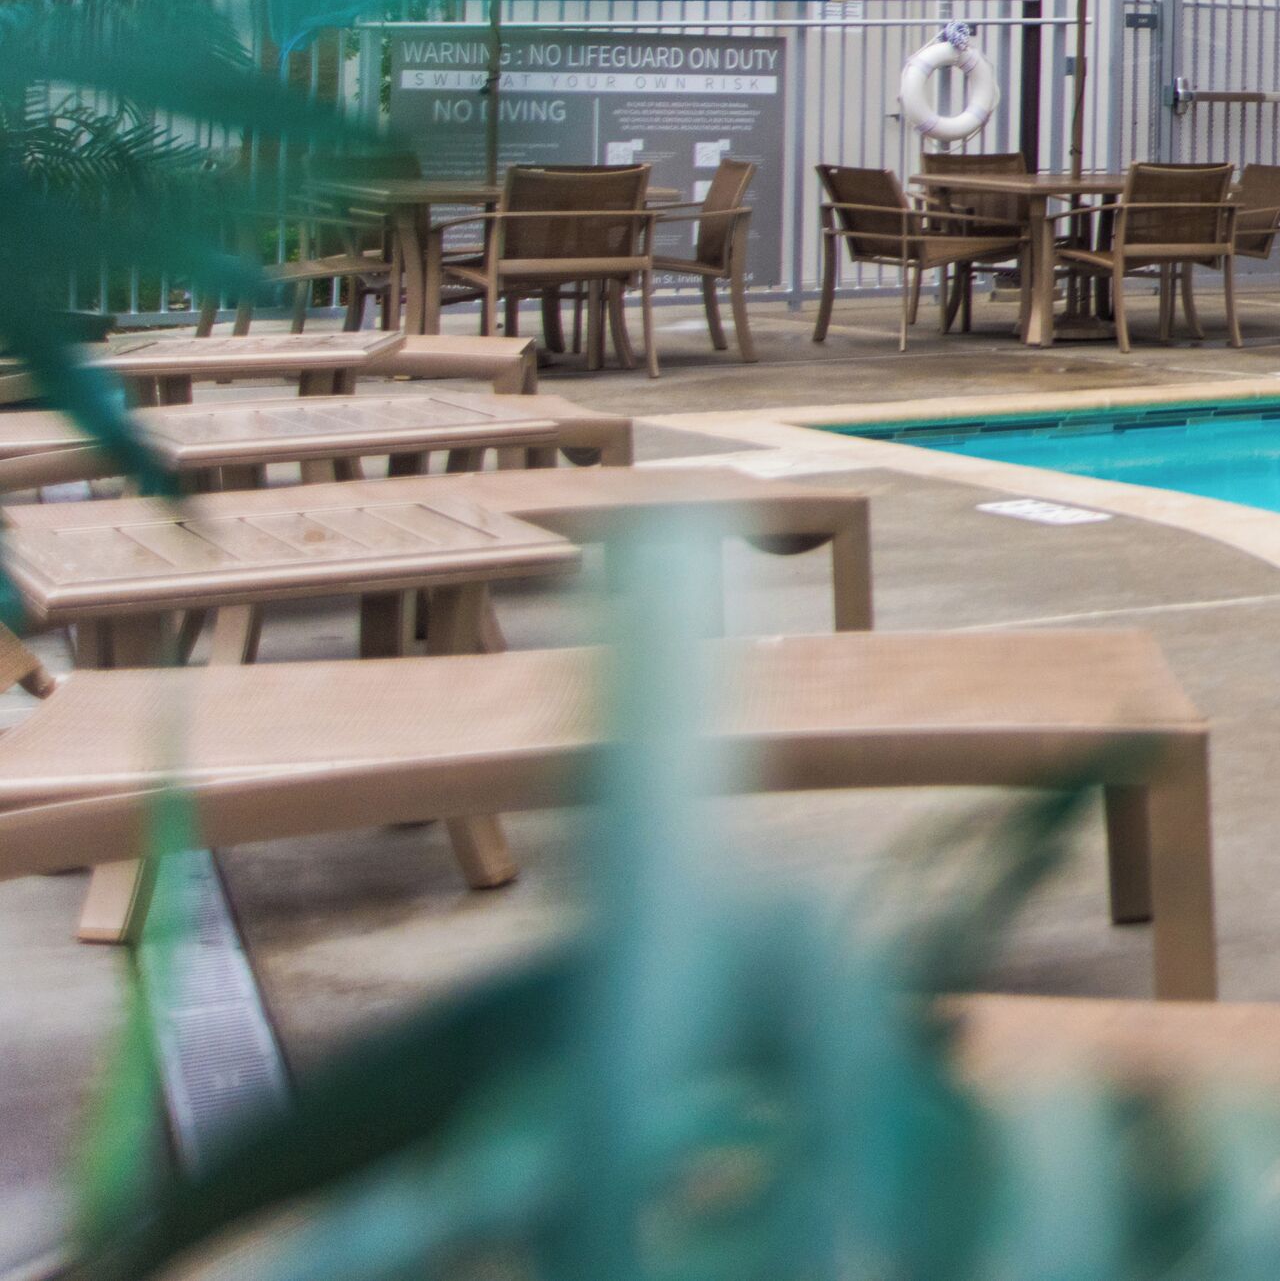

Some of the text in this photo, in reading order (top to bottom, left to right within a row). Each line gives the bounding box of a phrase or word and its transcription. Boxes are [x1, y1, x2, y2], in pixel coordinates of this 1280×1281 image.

[402, 41, 511, 65] WARNING
[529, 44, 562, 66] NO
[568, 45, 684, 68] LIFEGUARD
[689, 47, 719, 69] ON
[725, 48, 778, 70] DUTY
[415, 72, 761, 90] SWIM AT YOUR OWN RISK
[434, 100, 472, 122] NO
